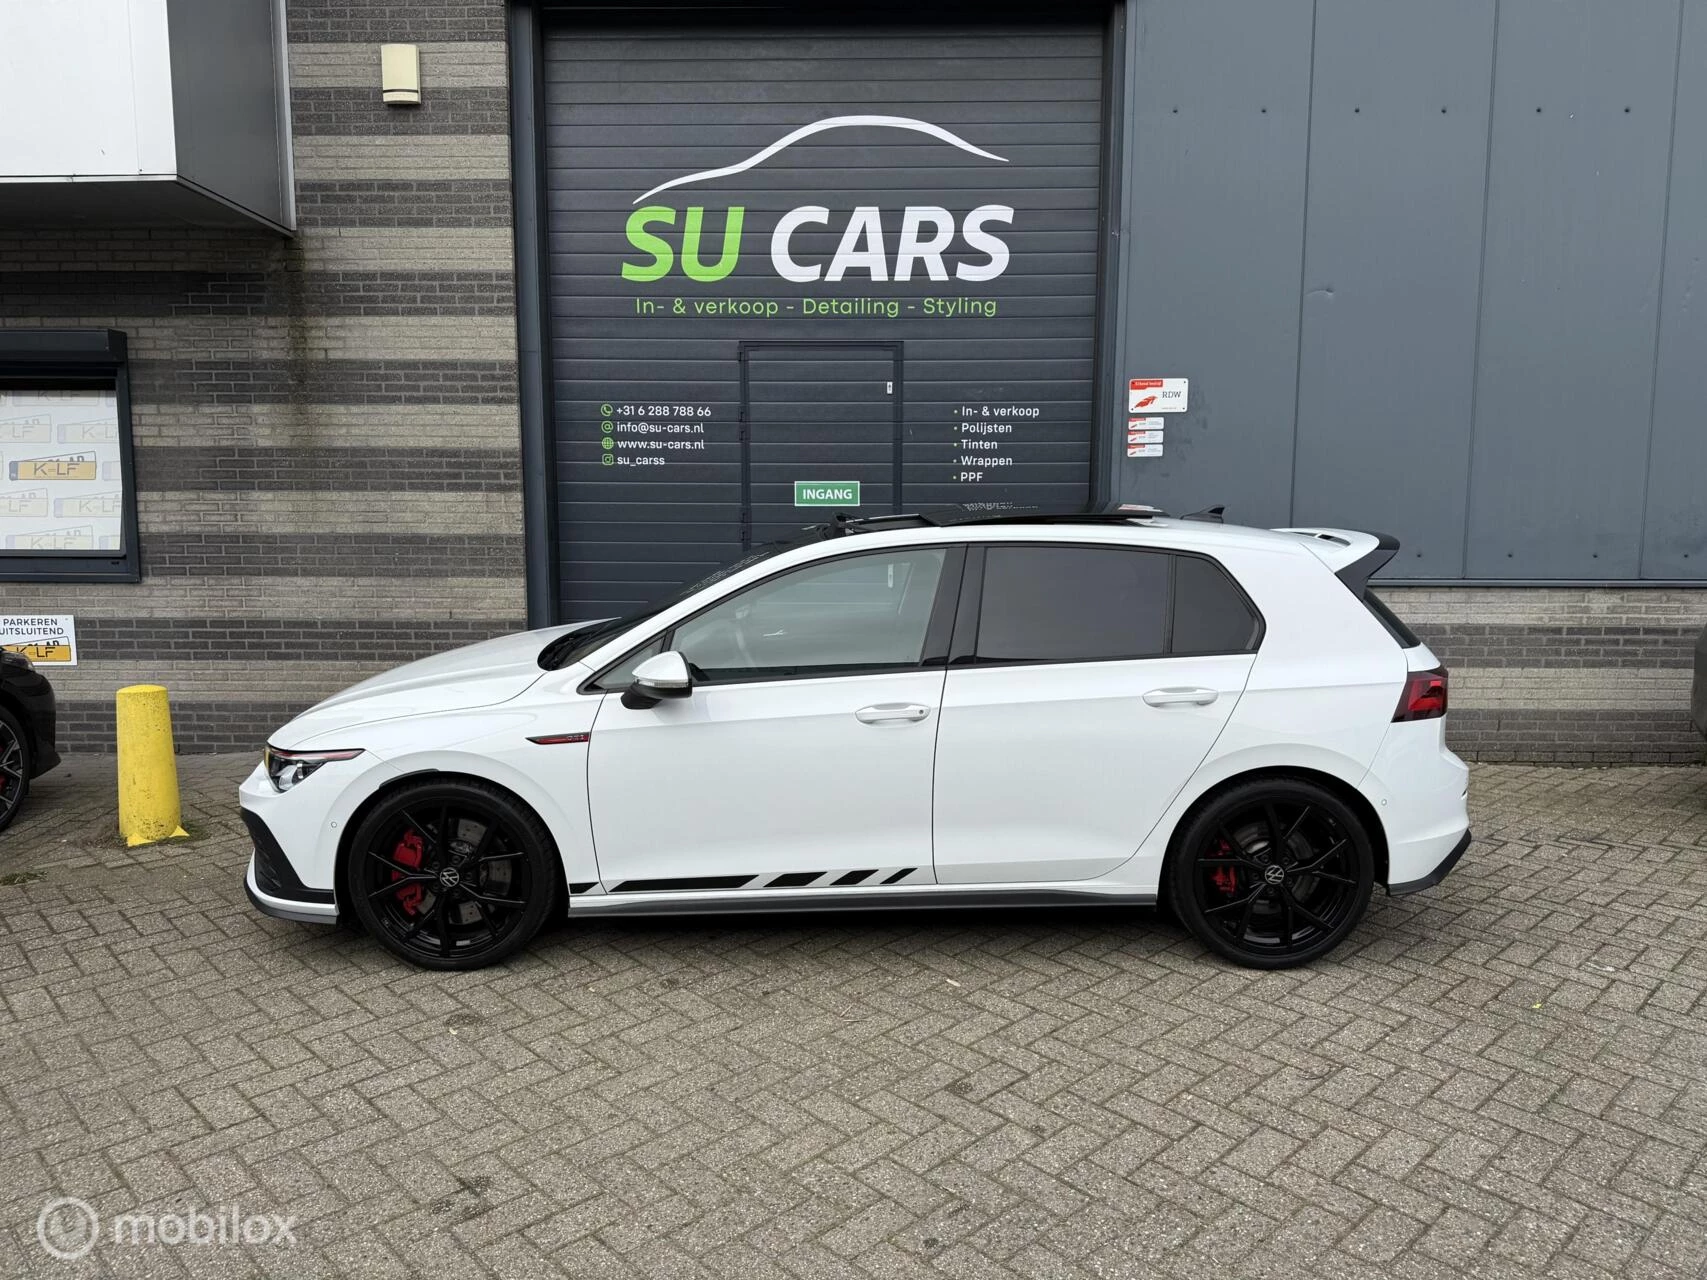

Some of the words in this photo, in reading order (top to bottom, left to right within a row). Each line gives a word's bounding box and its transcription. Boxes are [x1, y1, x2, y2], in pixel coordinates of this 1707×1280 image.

[621, 205, 745, 282] SU
[770, 204, 1014, 283] CARS
[635, 298, 664, 314] In-
[672, 298, 687, 315] &
[694, 298, 778, 317] verkoop
[802, 298, 899, 318] Detailing
[923, 298, 997, 318] Styling
[617, 405, 635, 416] +31
[637, 405, 645, 416] 6
[648, 406, 670, 416] 288
[673, 406, 694, 417] 788
[697, 406, 712, 417] 66
[962, 405, 978, 416] In-
[981, 405, 990, 417] &
[993, 406, 1040, 419] verkoop
[617, 422, 704, 434] info@su-cars.nl
[961, 422, 1013, 435] Polijsten
[617, 439, 705, 450] www.su-cars.nl
[961, 439, 998, 450] Tinten
[616, 456, 665, 467] su_carss
[960, 455, 1013, 468] Wrappen
[960, 472, 983, 482] PPF
[802, 488, 853, 500] INGANG
[3, 618, 58, 626] PARKEREN
[0, 627, 64, 636] UITSLUITEND
